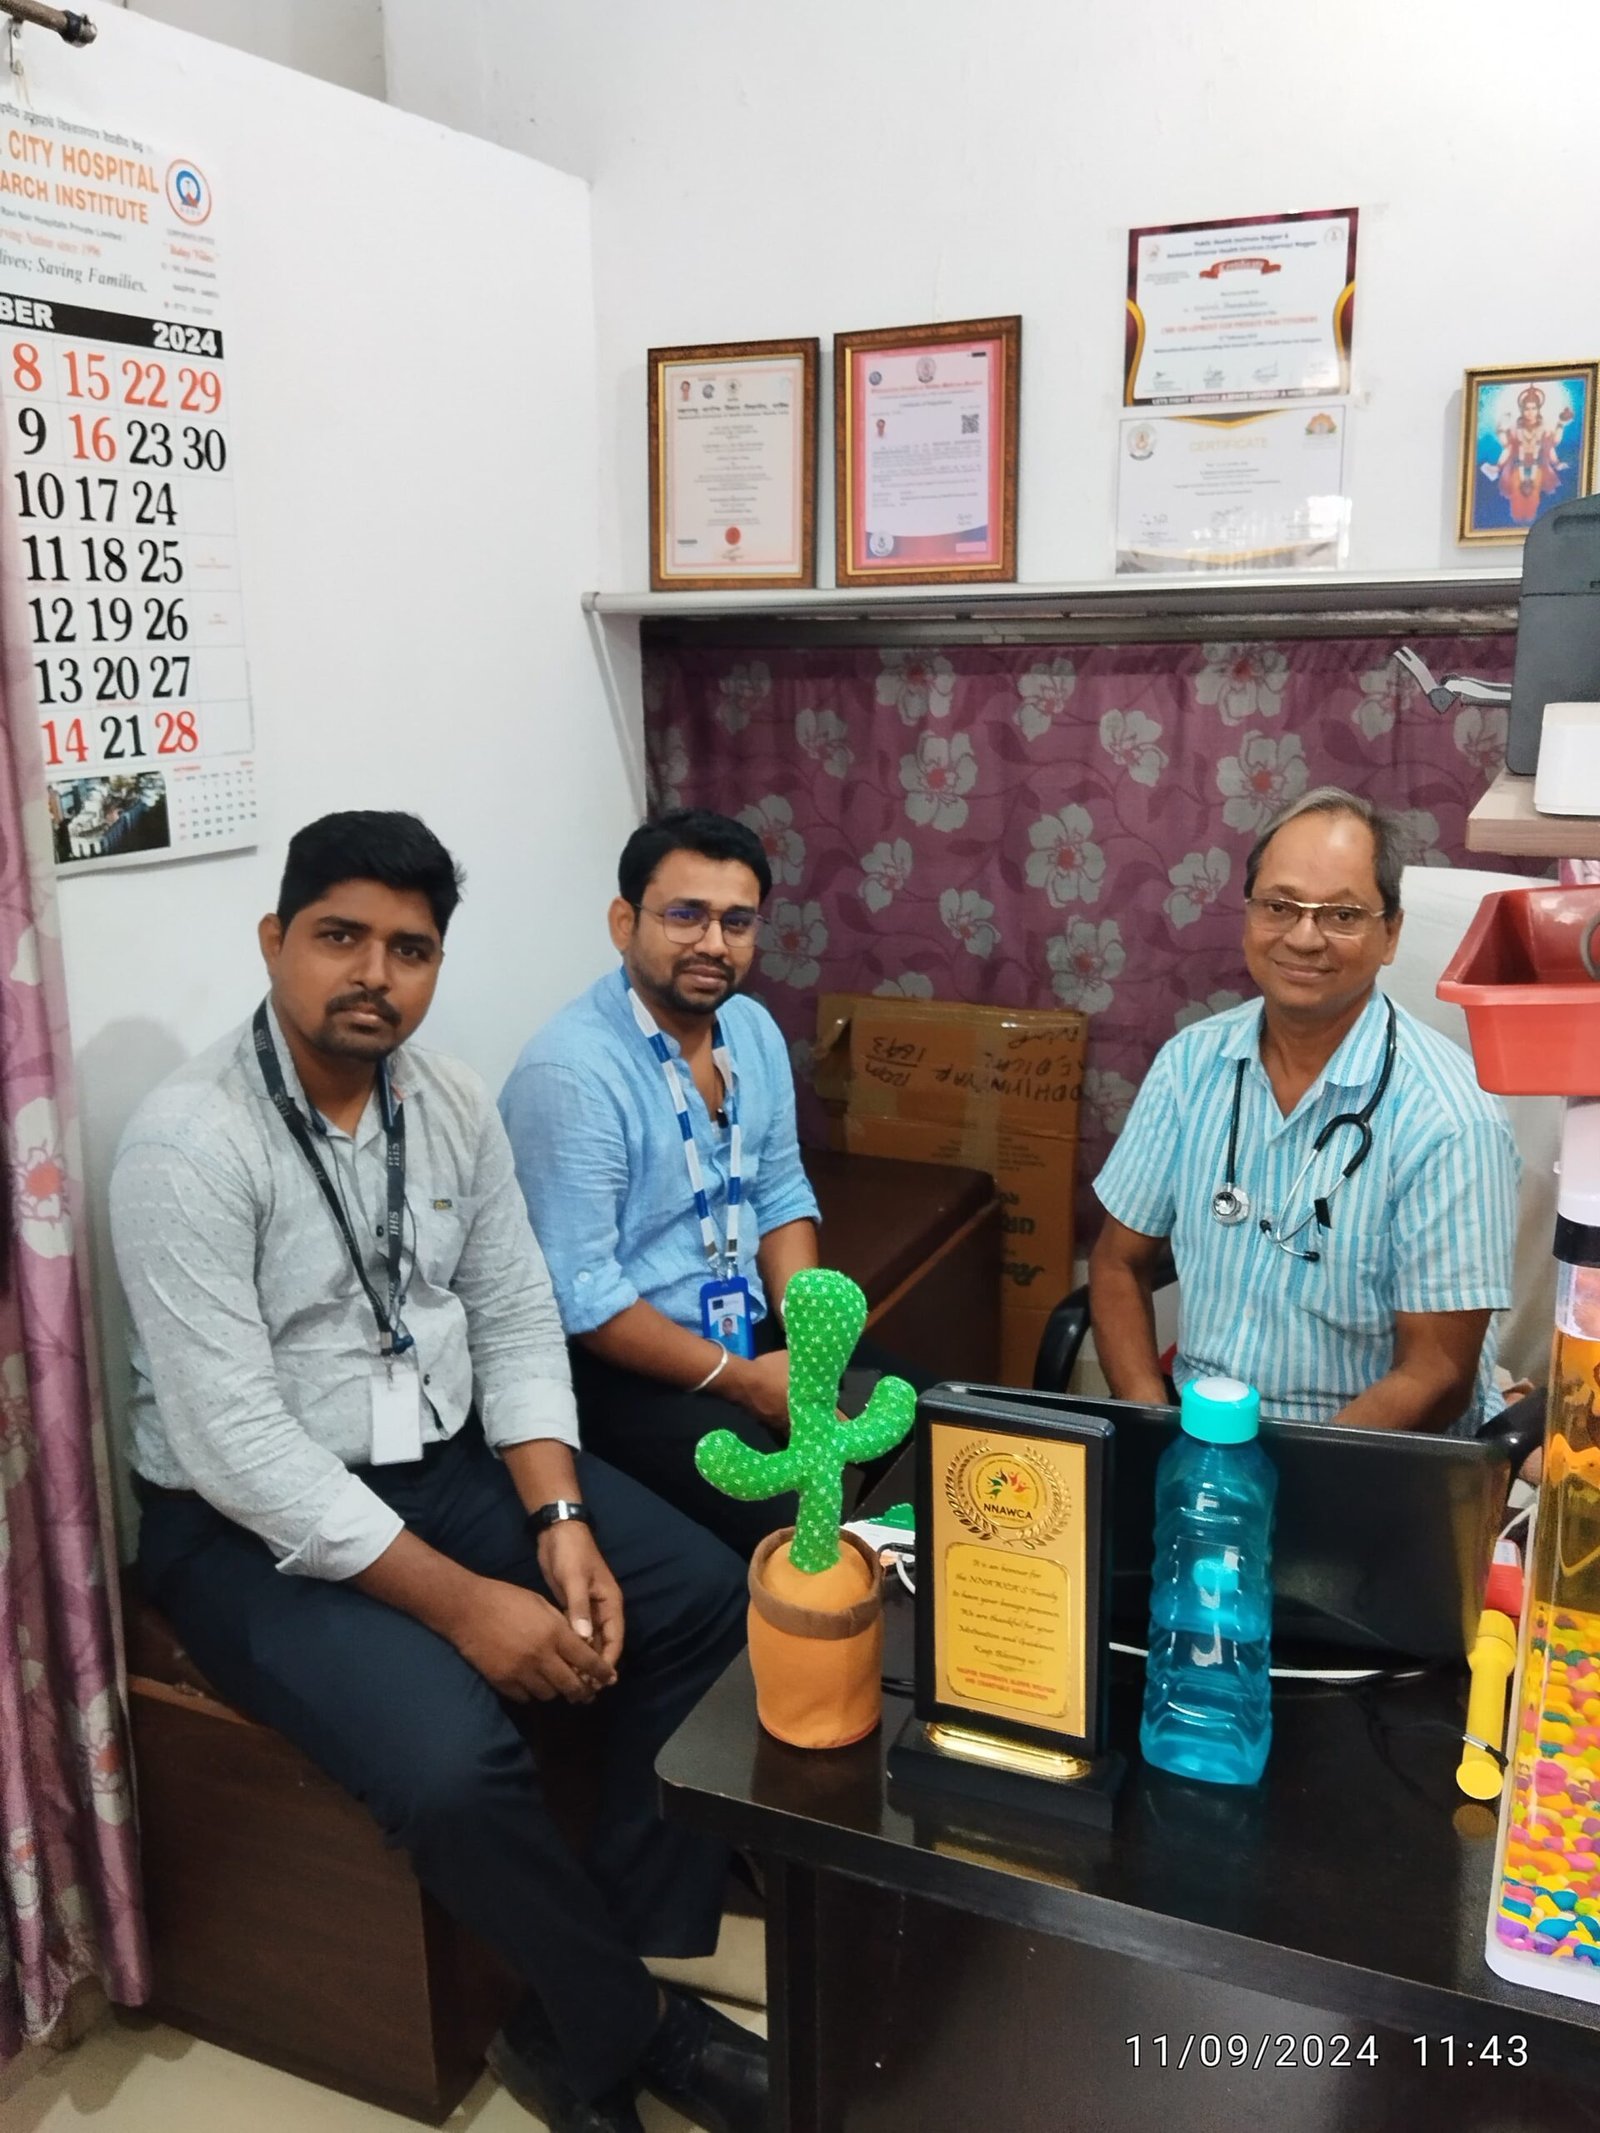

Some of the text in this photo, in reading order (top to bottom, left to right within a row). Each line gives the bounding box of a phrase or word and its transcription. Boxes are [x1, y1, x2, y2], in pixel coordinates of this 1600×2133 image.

[9, 130, 53, 168] CITY
[61, 144, 159, 194] HOSPITAL
[0, 169, 148, 224] ARCH INSTITUTE
[37, 256, 83, 284] Saving
[88, 266, 147, 293] Families.
[152, 321, 218, 356] 2024
[12, 343, 222, 414] 8 15 22 29
[18, 407, 226, 472] 9 16 23 30
[14, 470, 178, 526] 10 17 24
[22, 535, 183, 584] 11 18 25
[28, 597, 189, 643] 12 19 26
[34, 655, 190, 704] 13 20 27
[41, 711, 199, 765] 14 21 28
[388, 1210, 400, 1236] IHS
[983, 1503, 1033, 1520] NNAWCA
